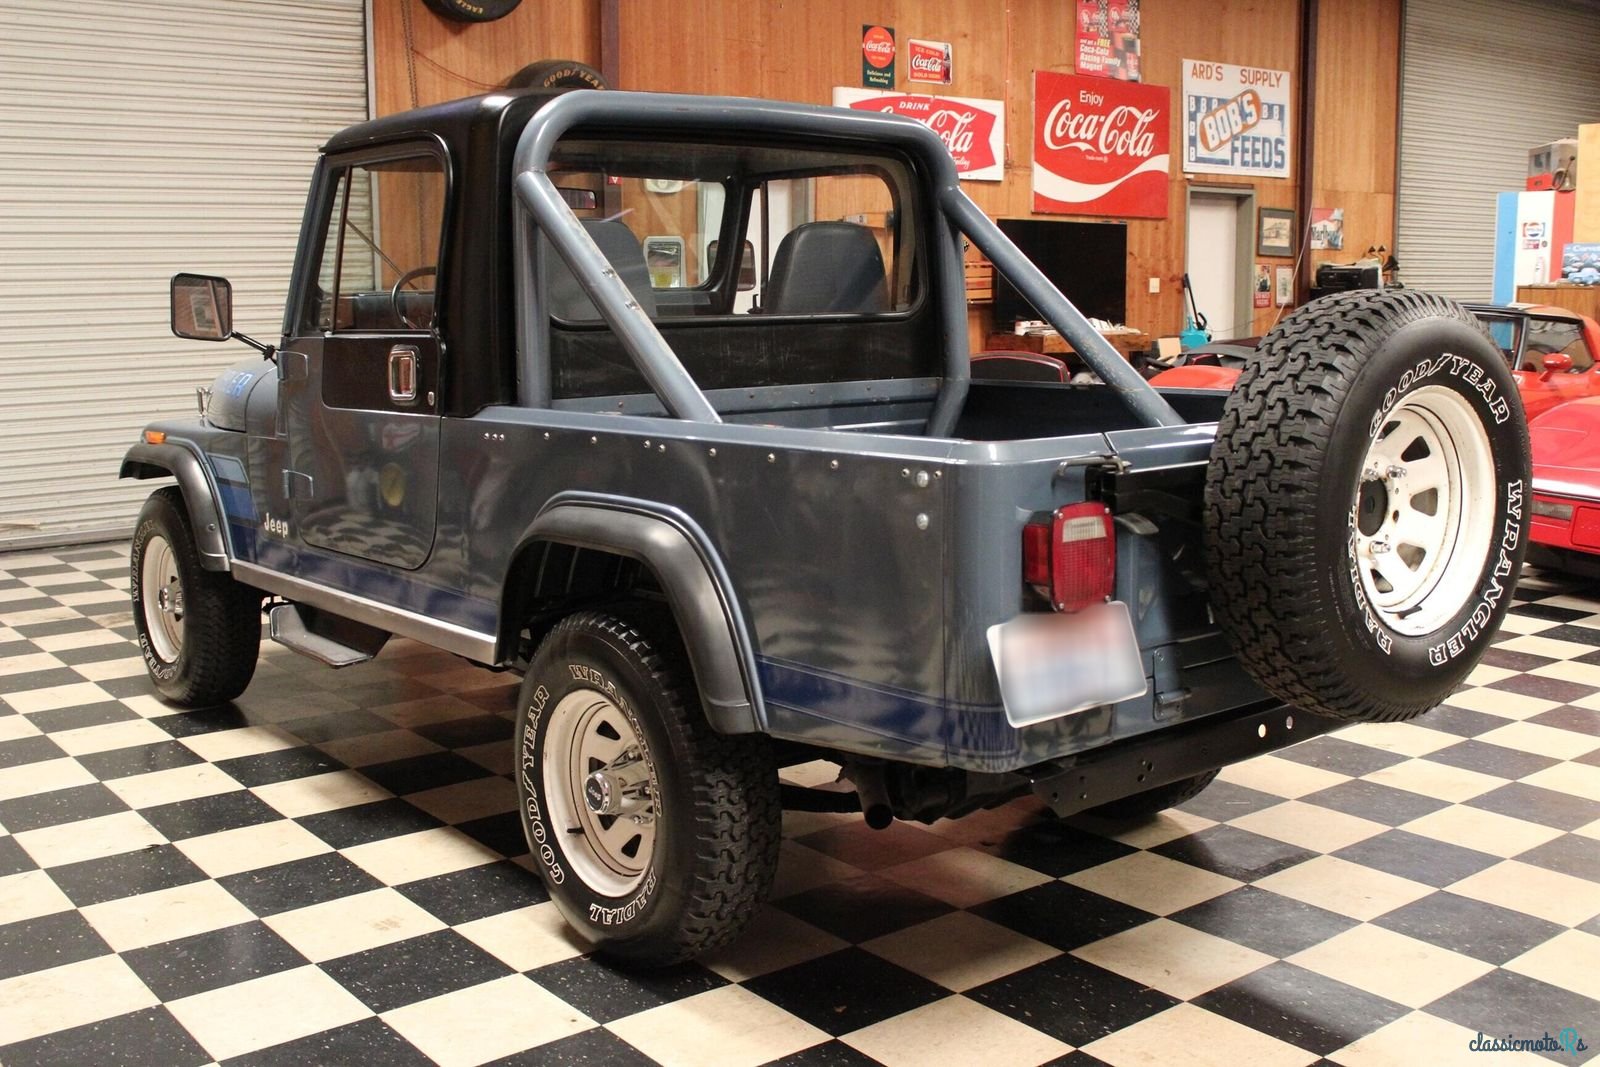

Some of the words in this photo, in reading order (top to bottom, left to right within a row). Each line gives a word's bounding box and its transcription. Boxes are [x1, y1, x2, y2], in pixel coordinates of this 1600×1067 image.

[866, 40, 892, 54] Coca-Cola
[1080, 44, 1109, 56] Coca-Cola
[912, 54, 943, 72] Coca-Cola
[1191, 62, 1223, 81] ARD'S
[1240, 68, 1282, 89] SUPPLY
[899, 101, 931, 111] DRINK
[1079, 90, 1104, 106] Enjoy
[1044, 98, 1160, 158] Coca-Cola
[1202, 92, 1259, 150] BOB'S
[1230, 135, 1286, 170] FEEDS
[263, 511, 289, 539] Jeep
[1347, 505, 1394, 656] RADIAL
[1429, 479, 1524, 667] WRANGLER
[589, 865, 657, 926] RADIAL
